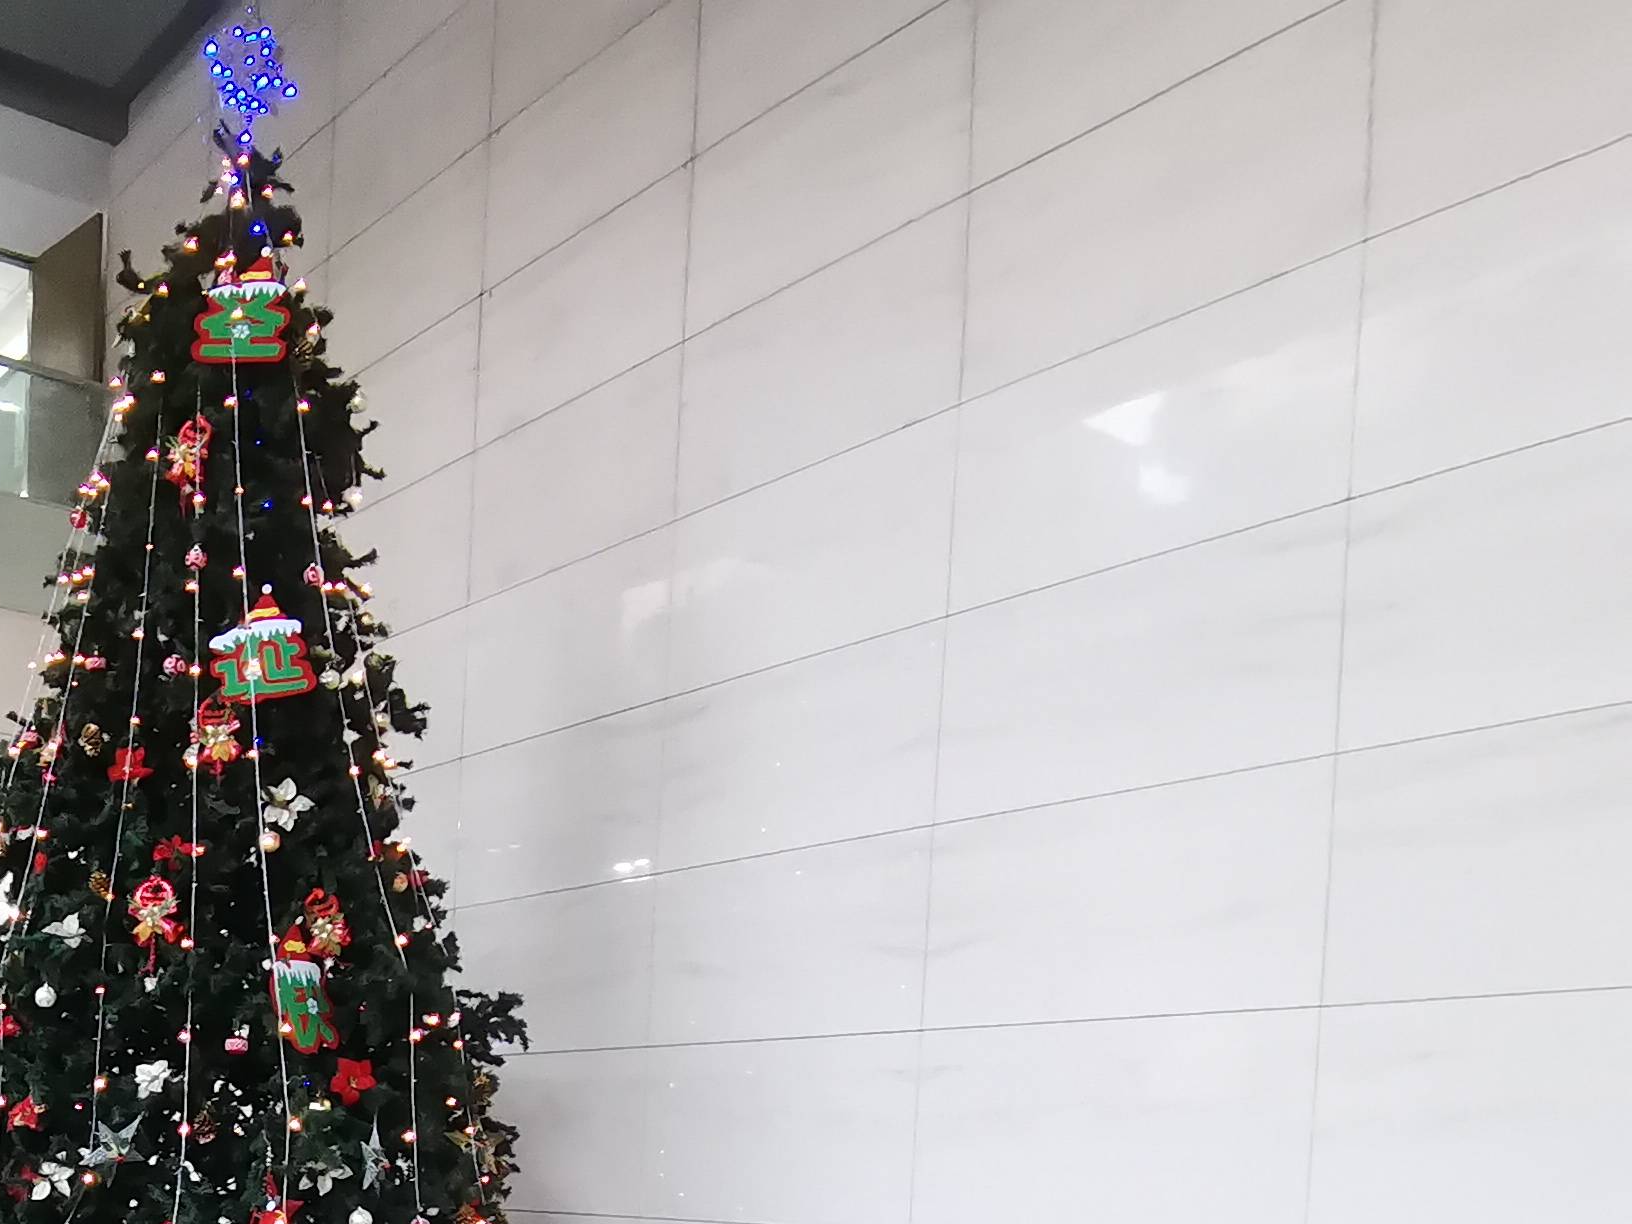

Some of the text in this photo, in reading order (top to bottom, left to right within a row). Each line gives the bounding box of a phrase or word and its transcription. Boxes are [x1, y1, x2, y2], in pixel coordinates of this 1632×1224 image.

[196, 282, 288, 362] 圣
[209, 620, 313, 703] 诞
[271, 960, 338, 1051] 快
